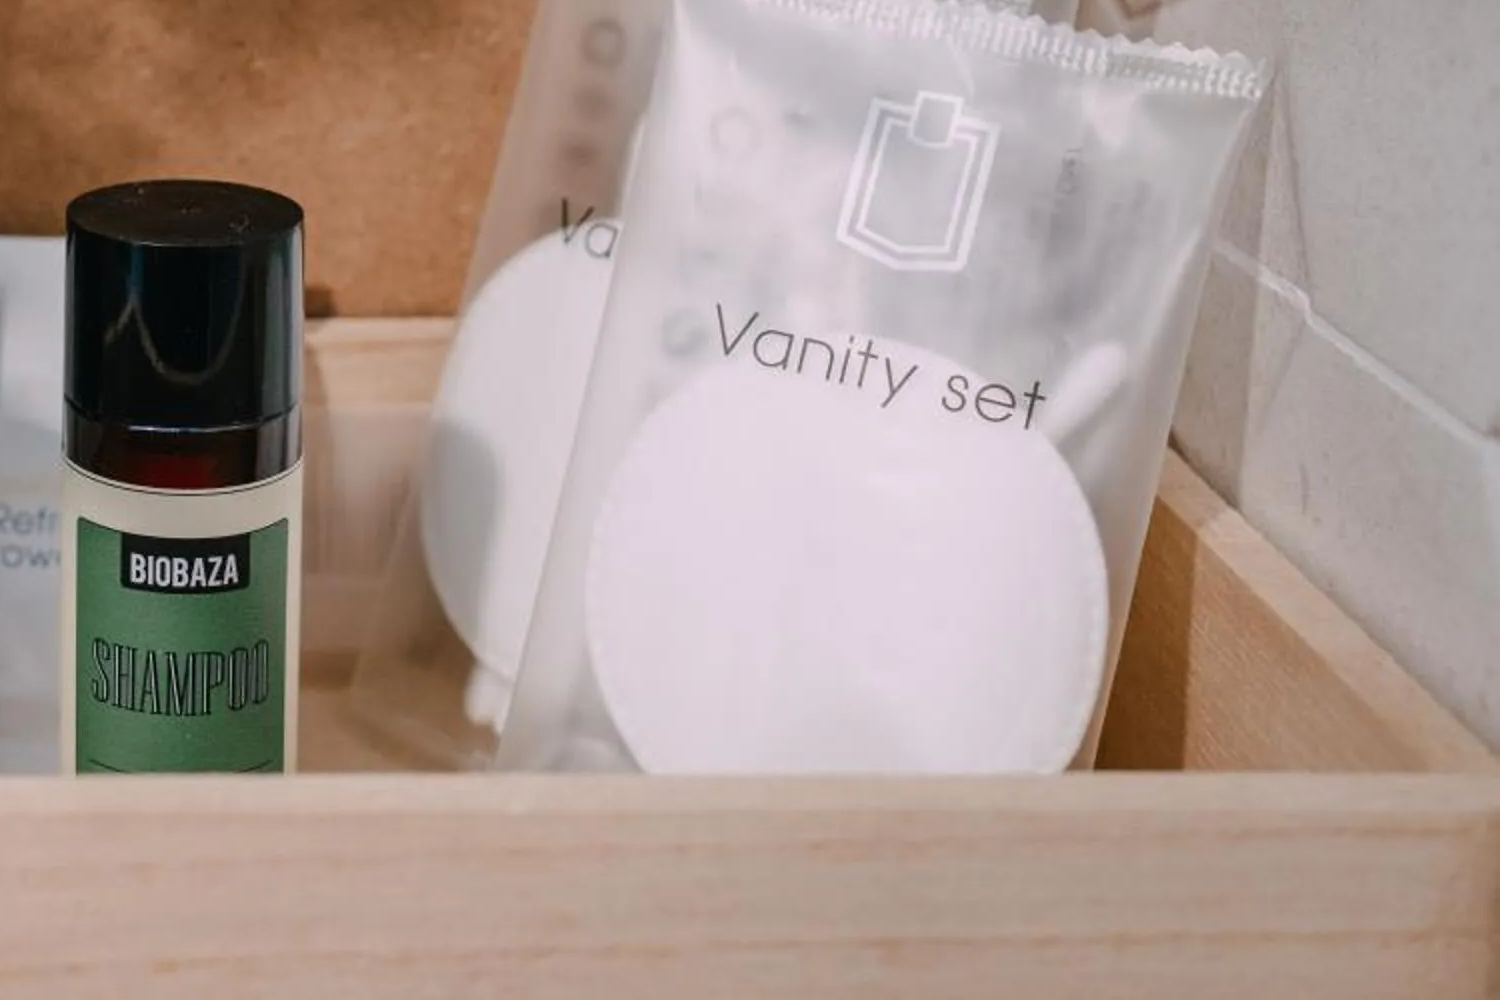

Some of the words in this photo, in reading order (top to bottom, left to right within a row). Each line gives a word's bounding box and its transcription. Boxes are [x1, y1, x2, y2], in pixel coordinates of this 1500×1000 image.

[561, 196, 619, 258] Va
[716, 302, 919, 408] Vanity
[941, 375, 1047, 430] set
[129, 553, 239, 588] BIOBAZA
[90, 637, 270, 717] SHAMPOO
